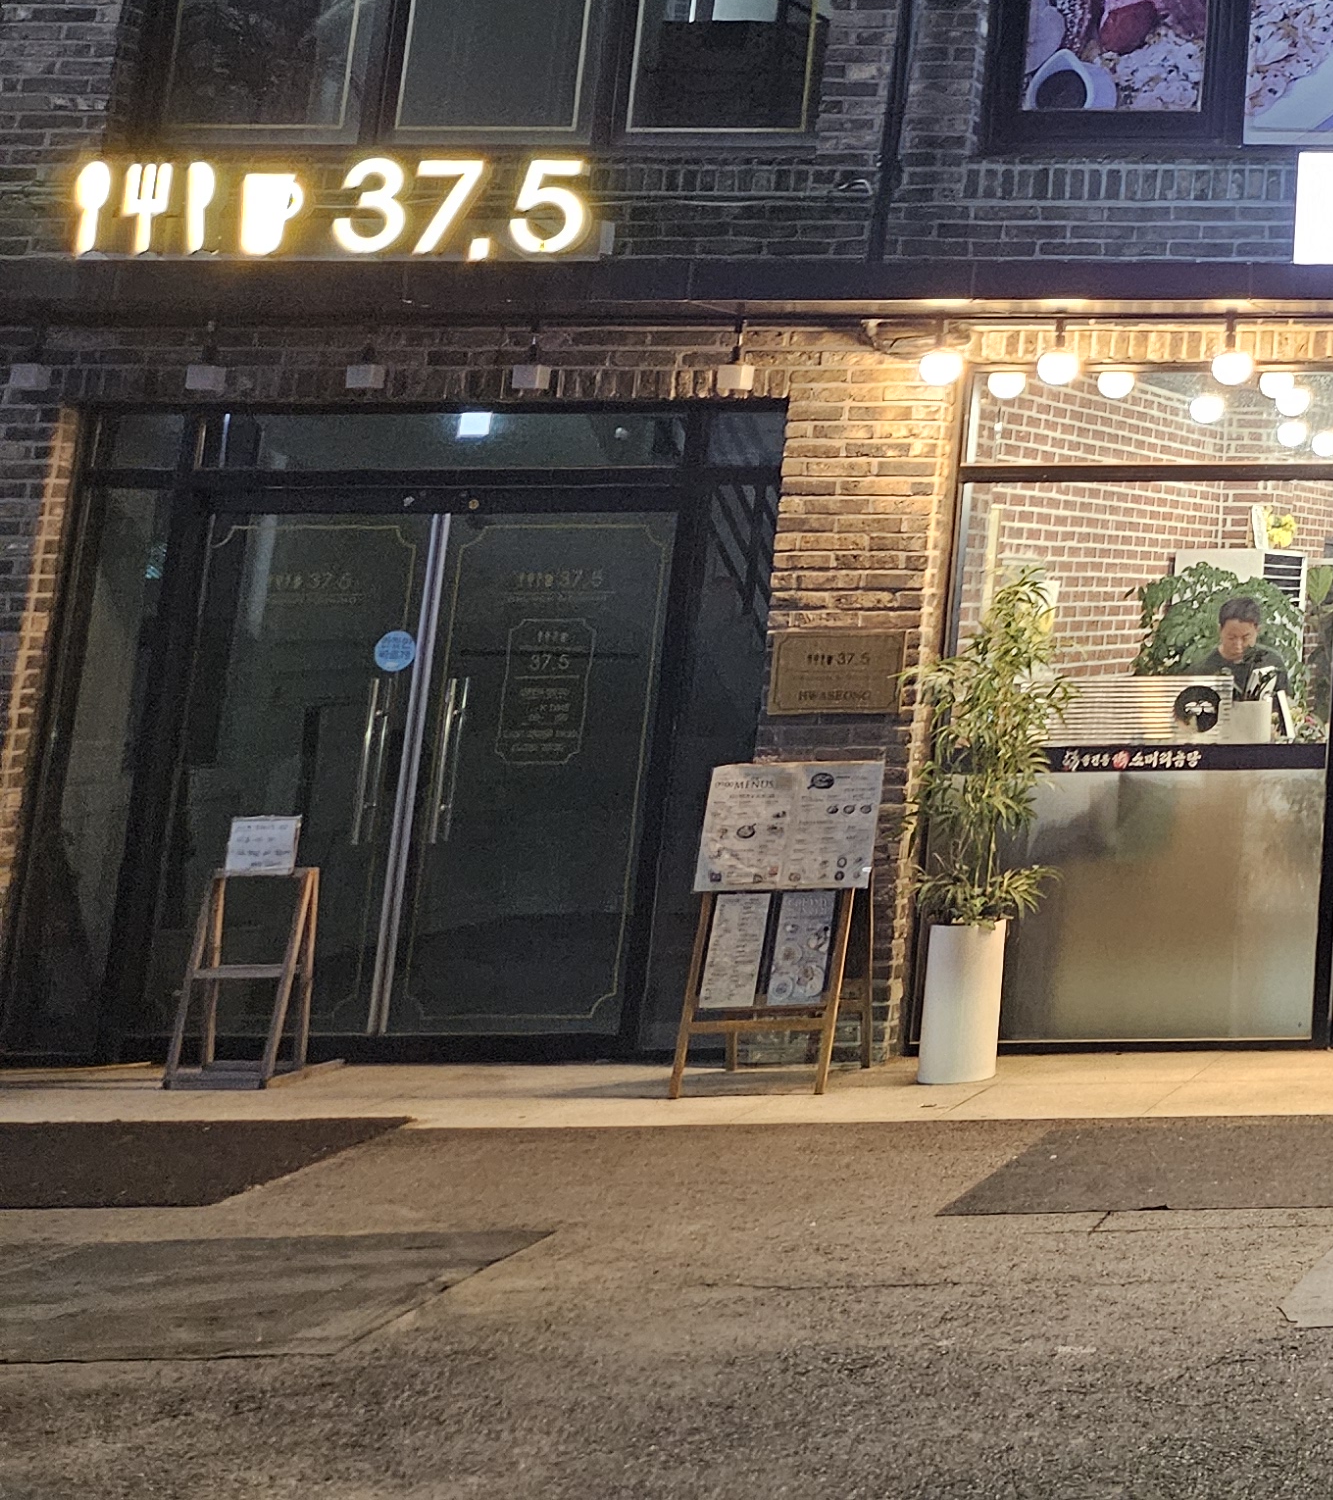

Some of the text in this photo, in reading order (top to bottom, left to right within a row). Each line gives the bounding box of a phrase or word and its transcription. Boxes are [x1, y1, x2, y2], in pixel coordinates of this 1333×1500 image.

[332, 157, 587, 262] 37.5
[529, 653, 570, 671] 37.5
[836, 651, 871, 666] 37.5
